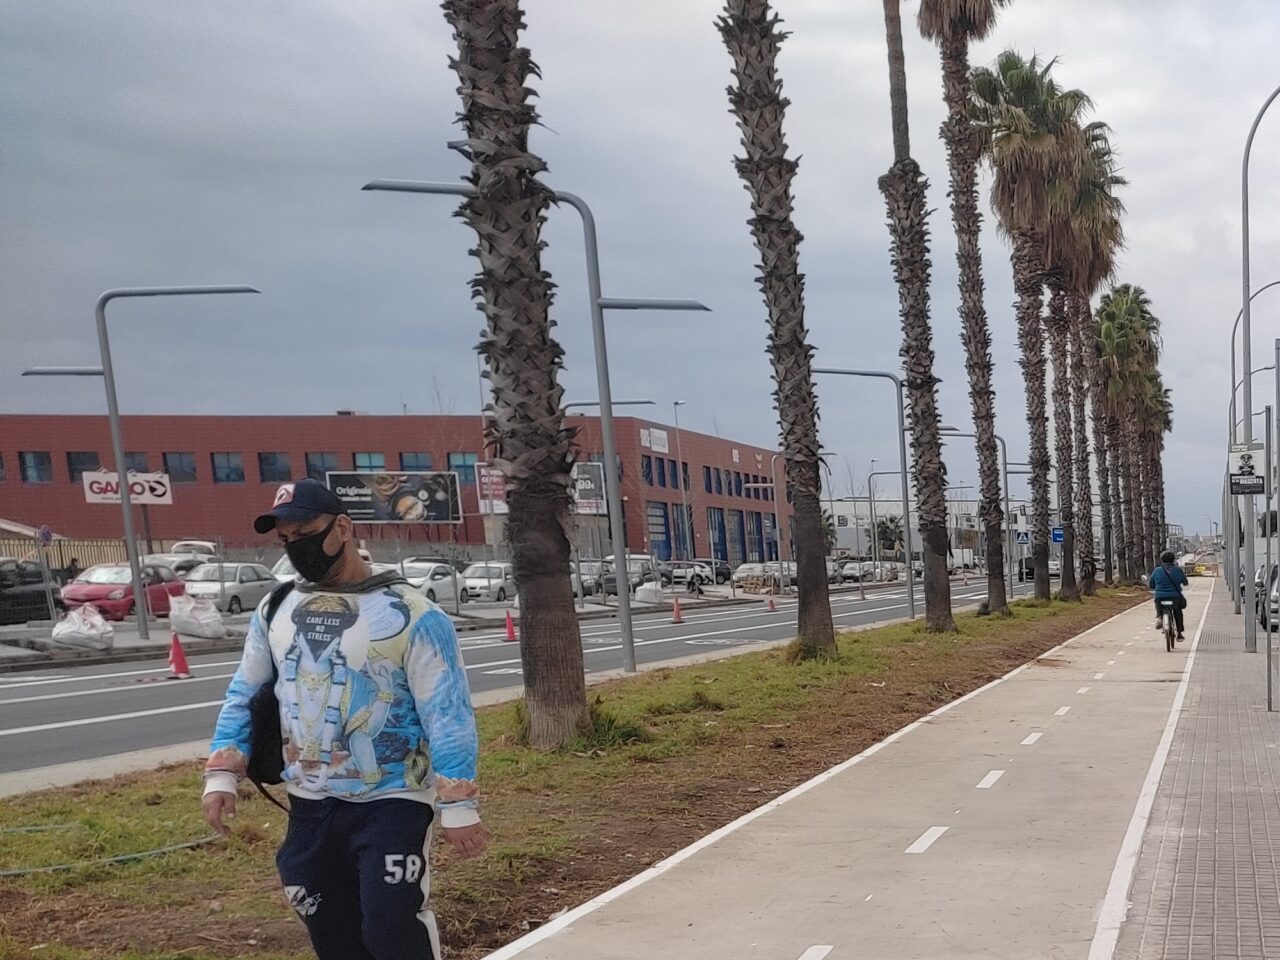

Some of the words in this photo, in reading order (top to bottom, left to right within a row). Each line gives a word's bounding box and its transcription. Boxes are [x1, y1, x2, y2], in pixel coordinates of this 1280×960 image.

[306, 616, 323, 625] CARE
[324, 617, 341, 626] LESS
[306, 632, 332, 641] STRESS
[384, 854, 422, 884] 58
